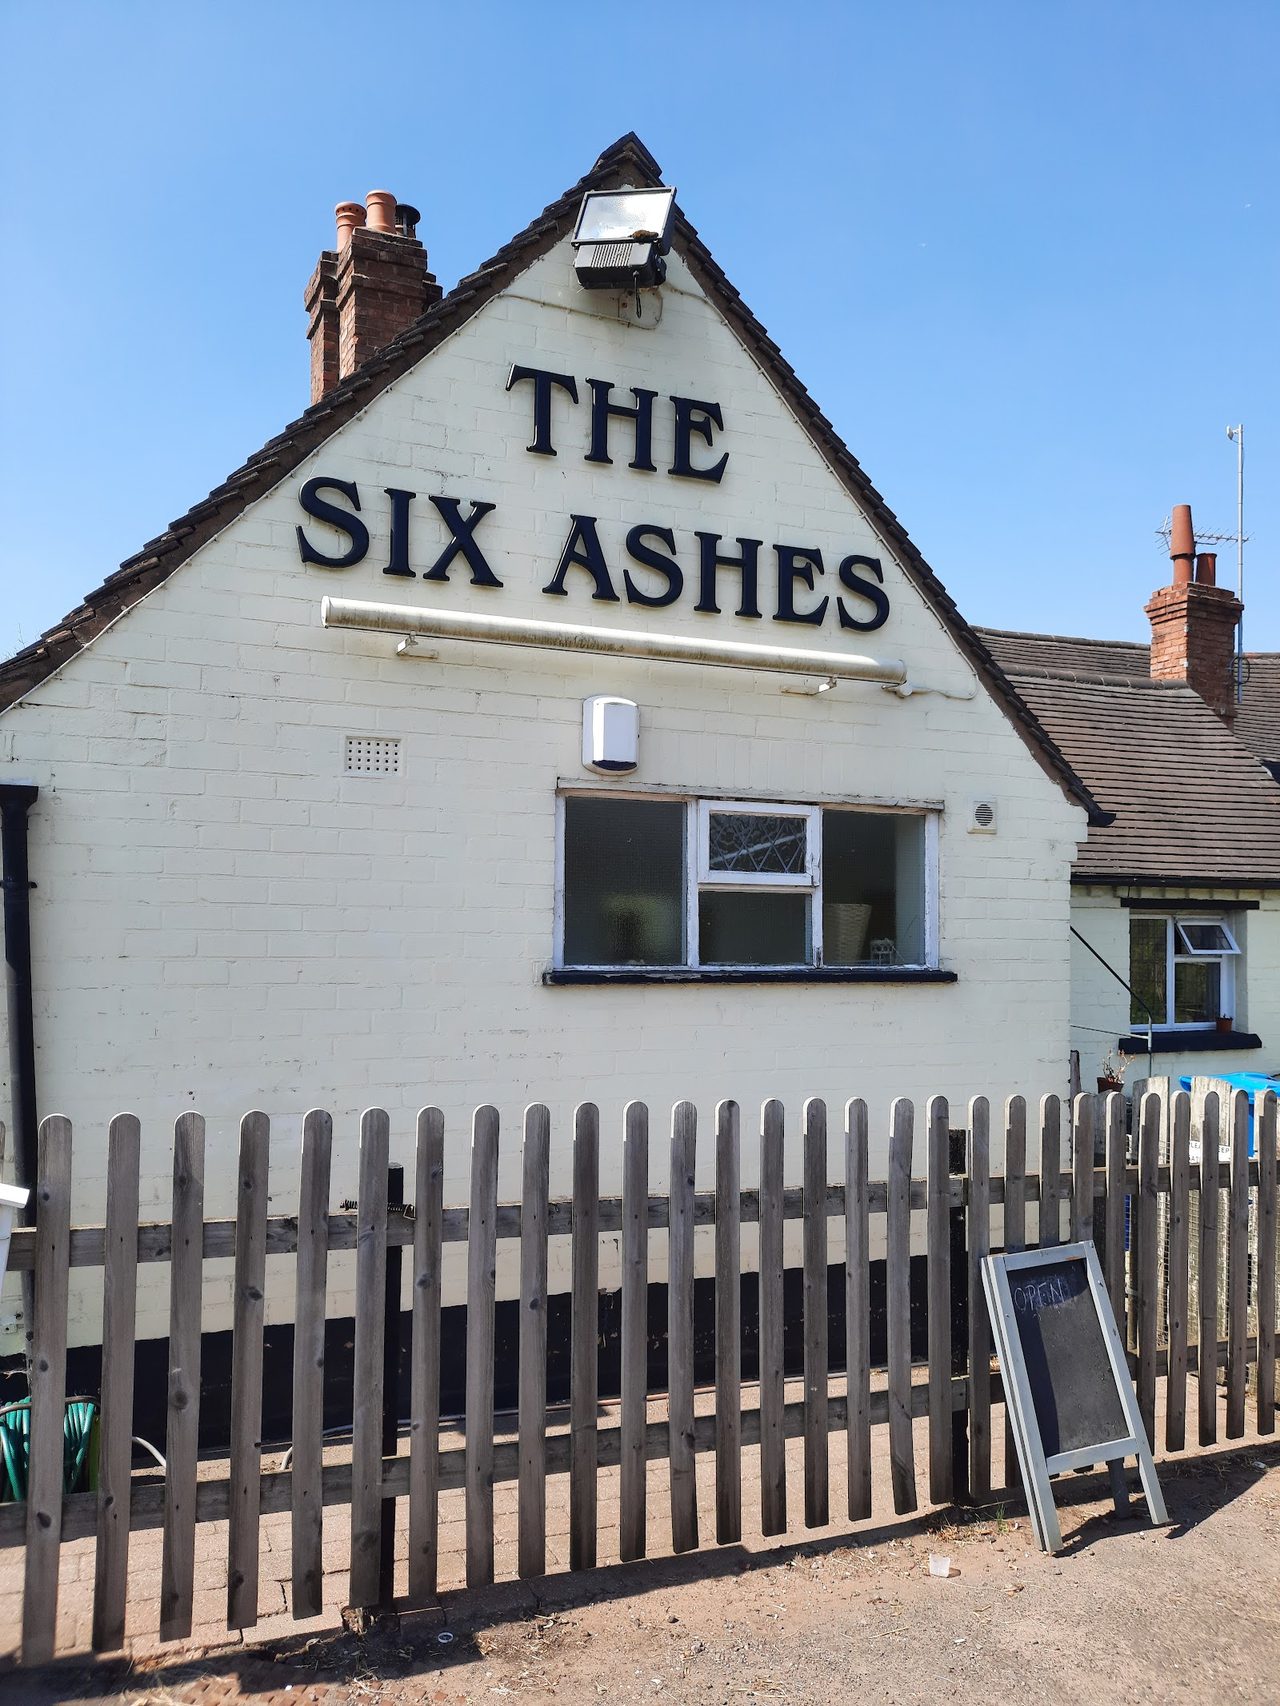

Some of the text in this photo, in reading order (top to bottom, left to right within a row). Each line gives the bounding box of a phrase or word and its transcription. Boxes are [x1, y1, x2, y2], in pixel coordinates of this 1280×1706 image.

[505, 363, 730, 484] THE
[295, 475, 891, 633] SIX ASHES
[1014, 1278, 1065, 1312] OPEN
